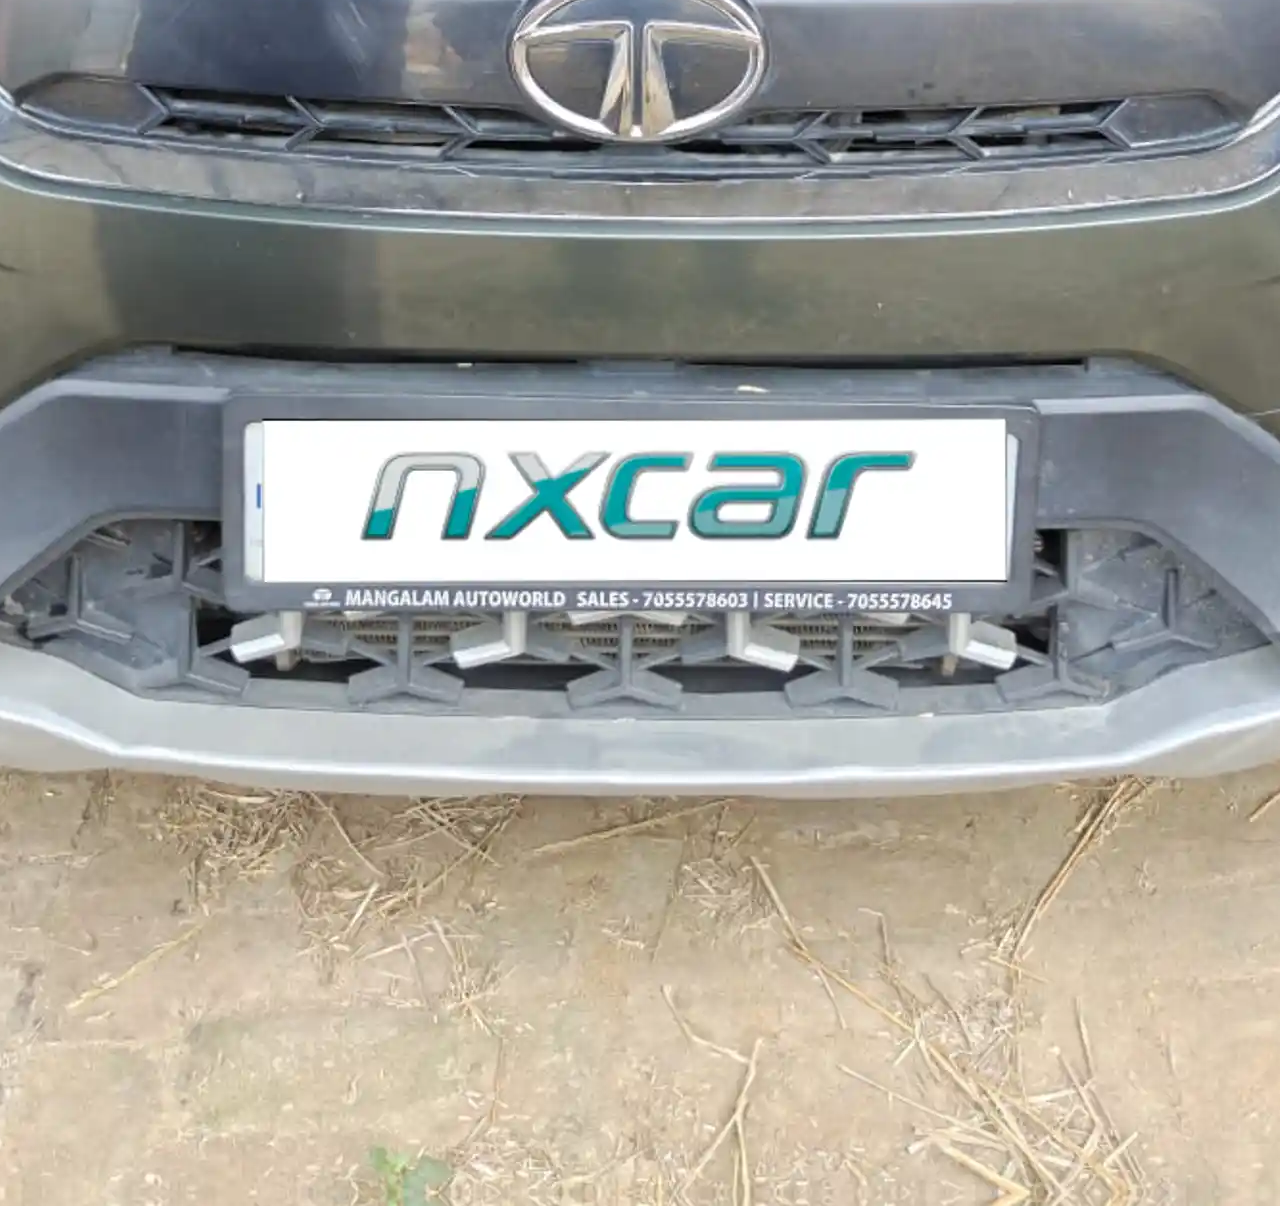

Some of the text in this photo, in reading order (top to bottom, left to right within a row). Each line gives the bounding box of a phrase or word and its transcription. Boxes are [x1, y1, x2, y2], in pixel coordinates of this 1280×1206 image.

[344, 589, 450, 608] MANGALAM
[452, 589, 567, 608] AUTOWORLD
[576, 590, 630, 609] SALES
[642, 591, 749, 609] 7055578603
[763, 592, 834, 610] SERVICE
[847, 592, 953, 610] 7055578645
